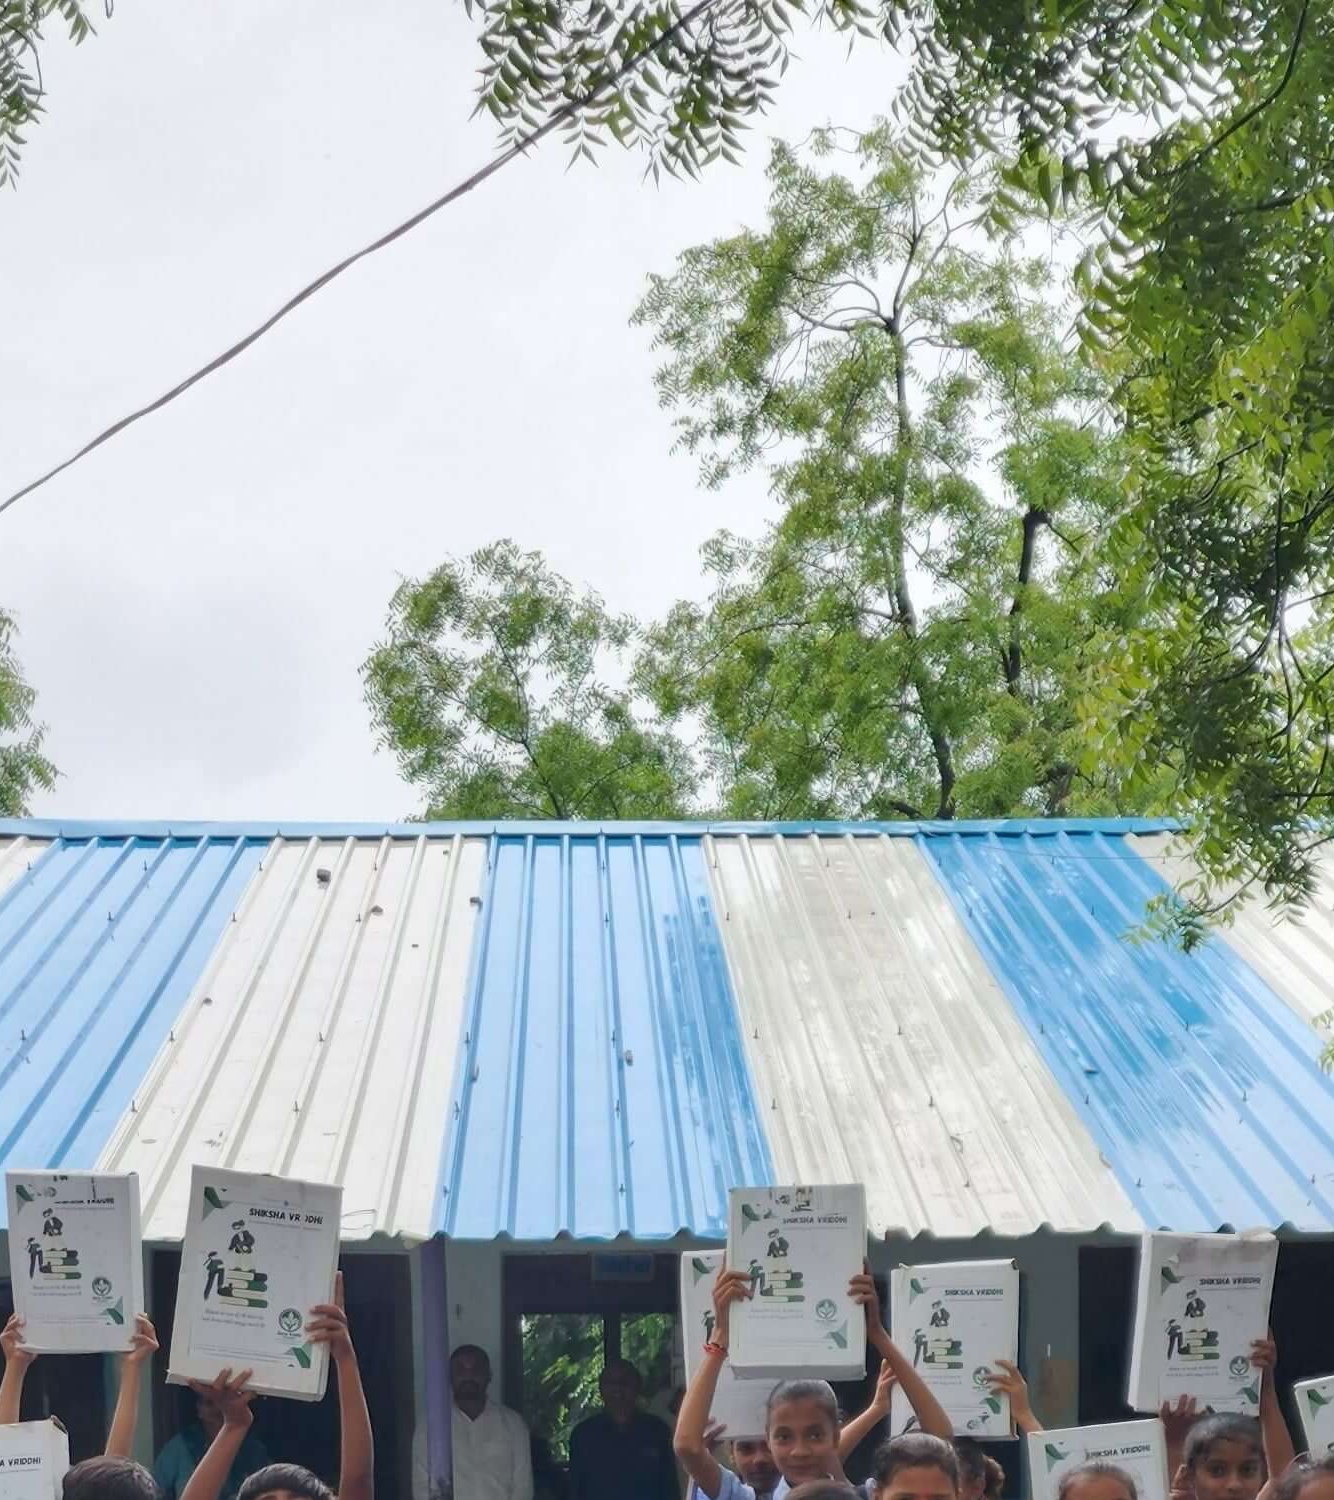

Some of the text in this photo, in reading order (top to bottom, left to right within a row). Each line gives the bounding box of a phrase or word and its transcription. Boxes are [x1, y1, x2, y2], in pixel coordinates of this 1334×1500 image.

[249, 1208, 286, 1221] SHIKSHA
[976, 1288, 1004, 1296] VRIDDHI
[8, 1457, 40, 1466] VRIDDHI
